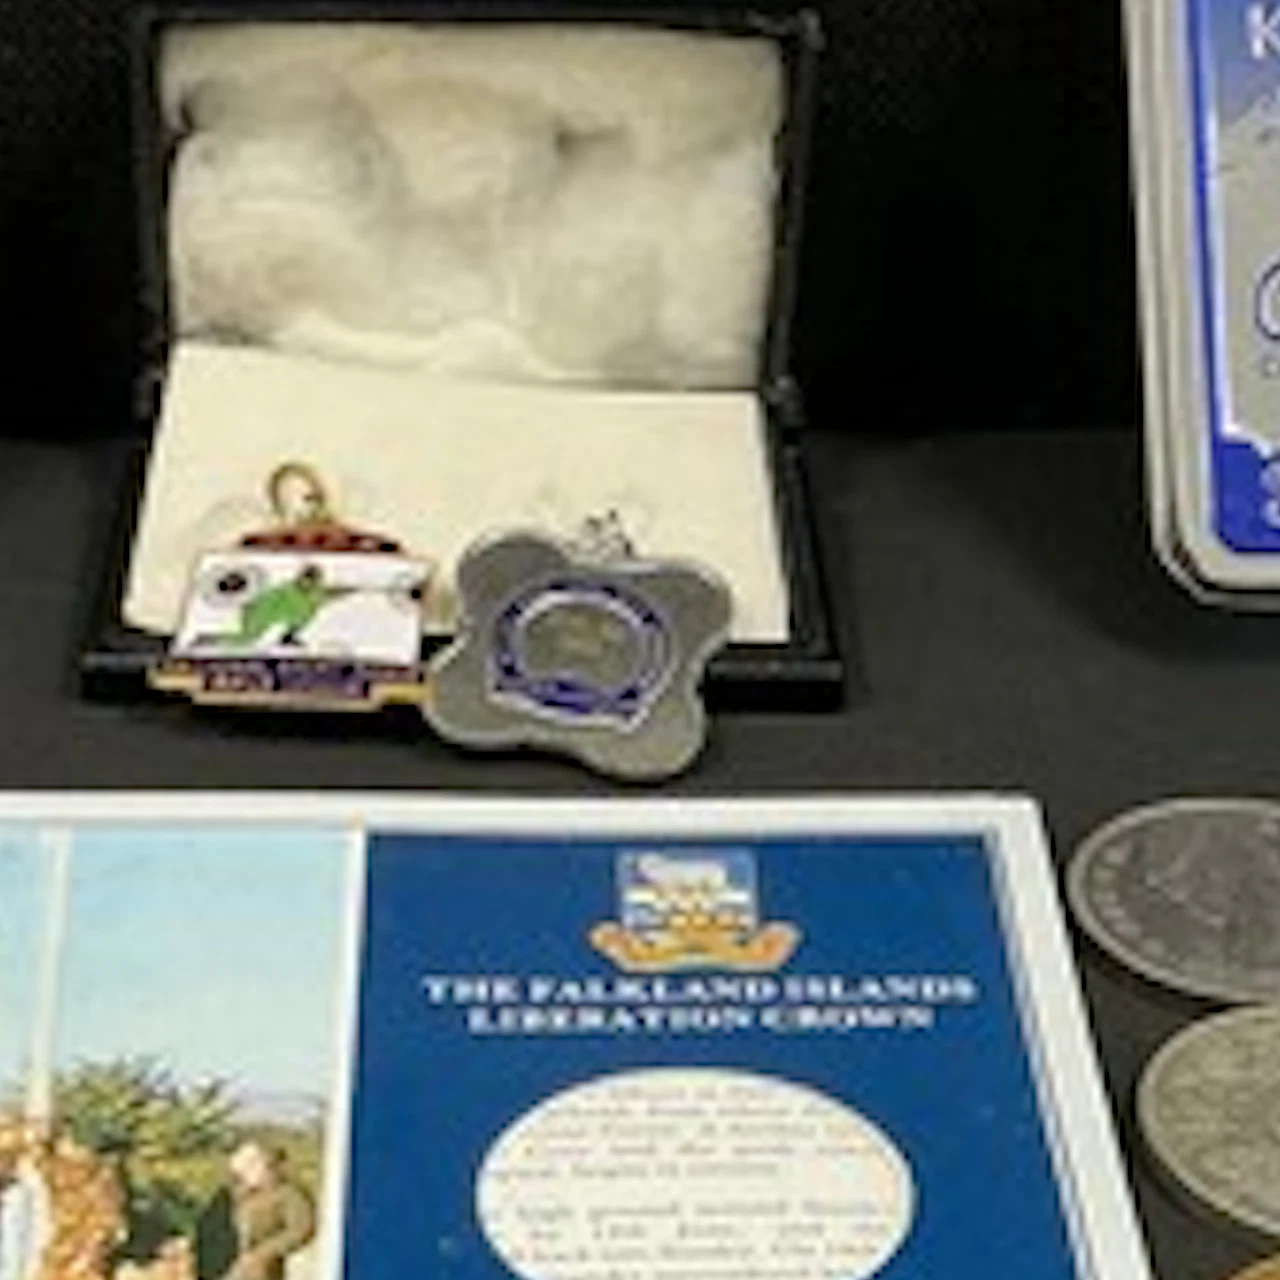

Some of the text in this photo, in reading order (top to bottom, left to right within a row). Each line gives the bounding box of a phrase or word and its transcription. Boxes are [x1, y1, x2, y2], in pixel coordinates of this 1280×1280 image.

[422, 974, 977, 1005] THE FALKLAND ISLANDS
[467, 1004, 936, 1036] LIBERATION CROWN
